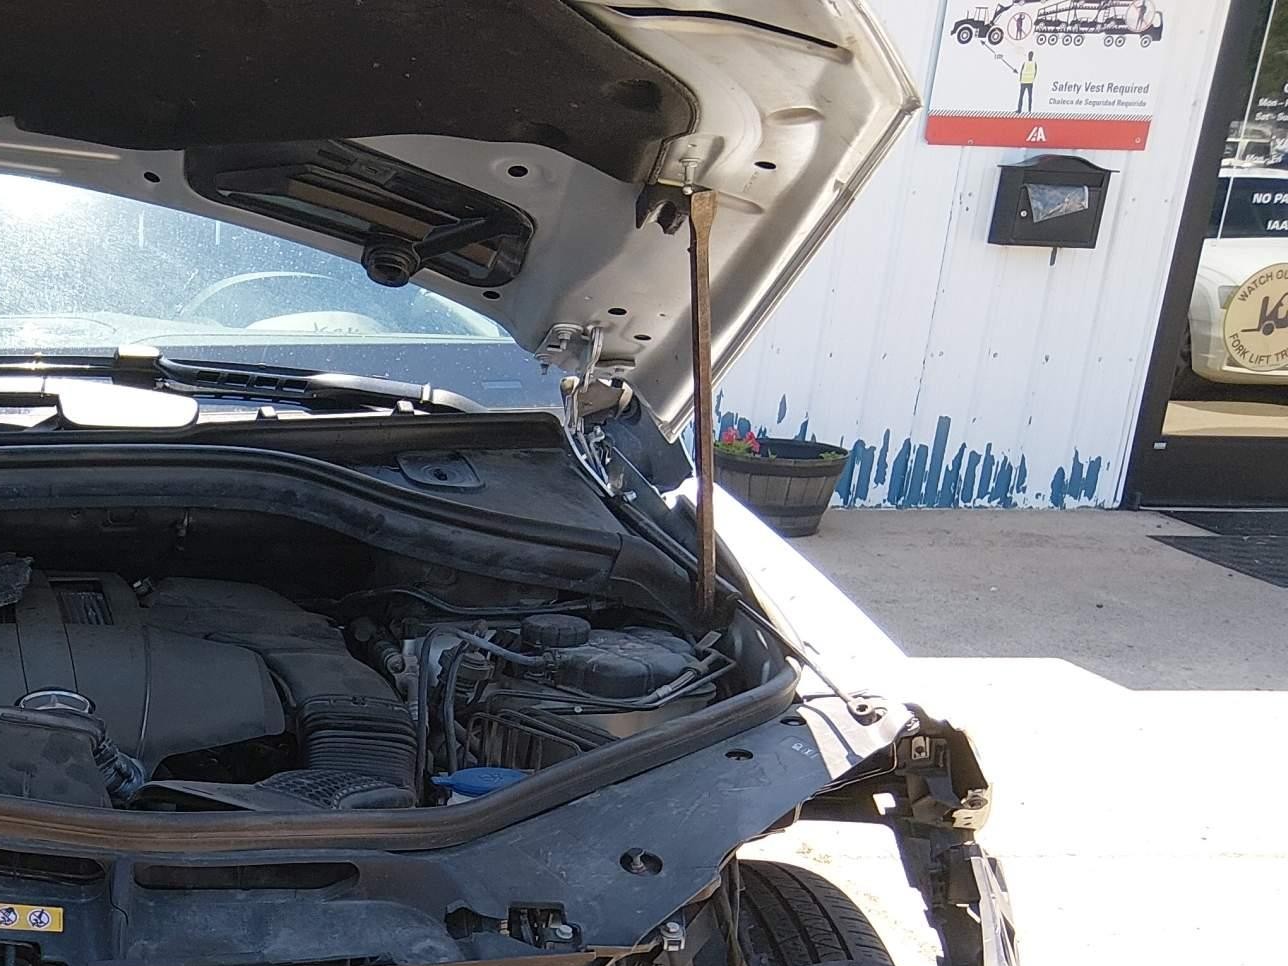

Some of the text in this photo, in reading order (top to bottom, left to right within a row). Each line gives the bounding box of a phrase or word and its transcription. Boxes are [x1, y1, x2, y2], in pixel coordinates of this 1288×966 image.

[1052, 81, 1150, 96] Safety Vest Required
[1252, 192, 1272, 204] NO
[1266, 219, 1288, 231] IAA
[1238, 271, 1273, 302] WATCH
[1229, 332, 1250, 360] FORK
[1248, 352, 1272, 365] LIFT
